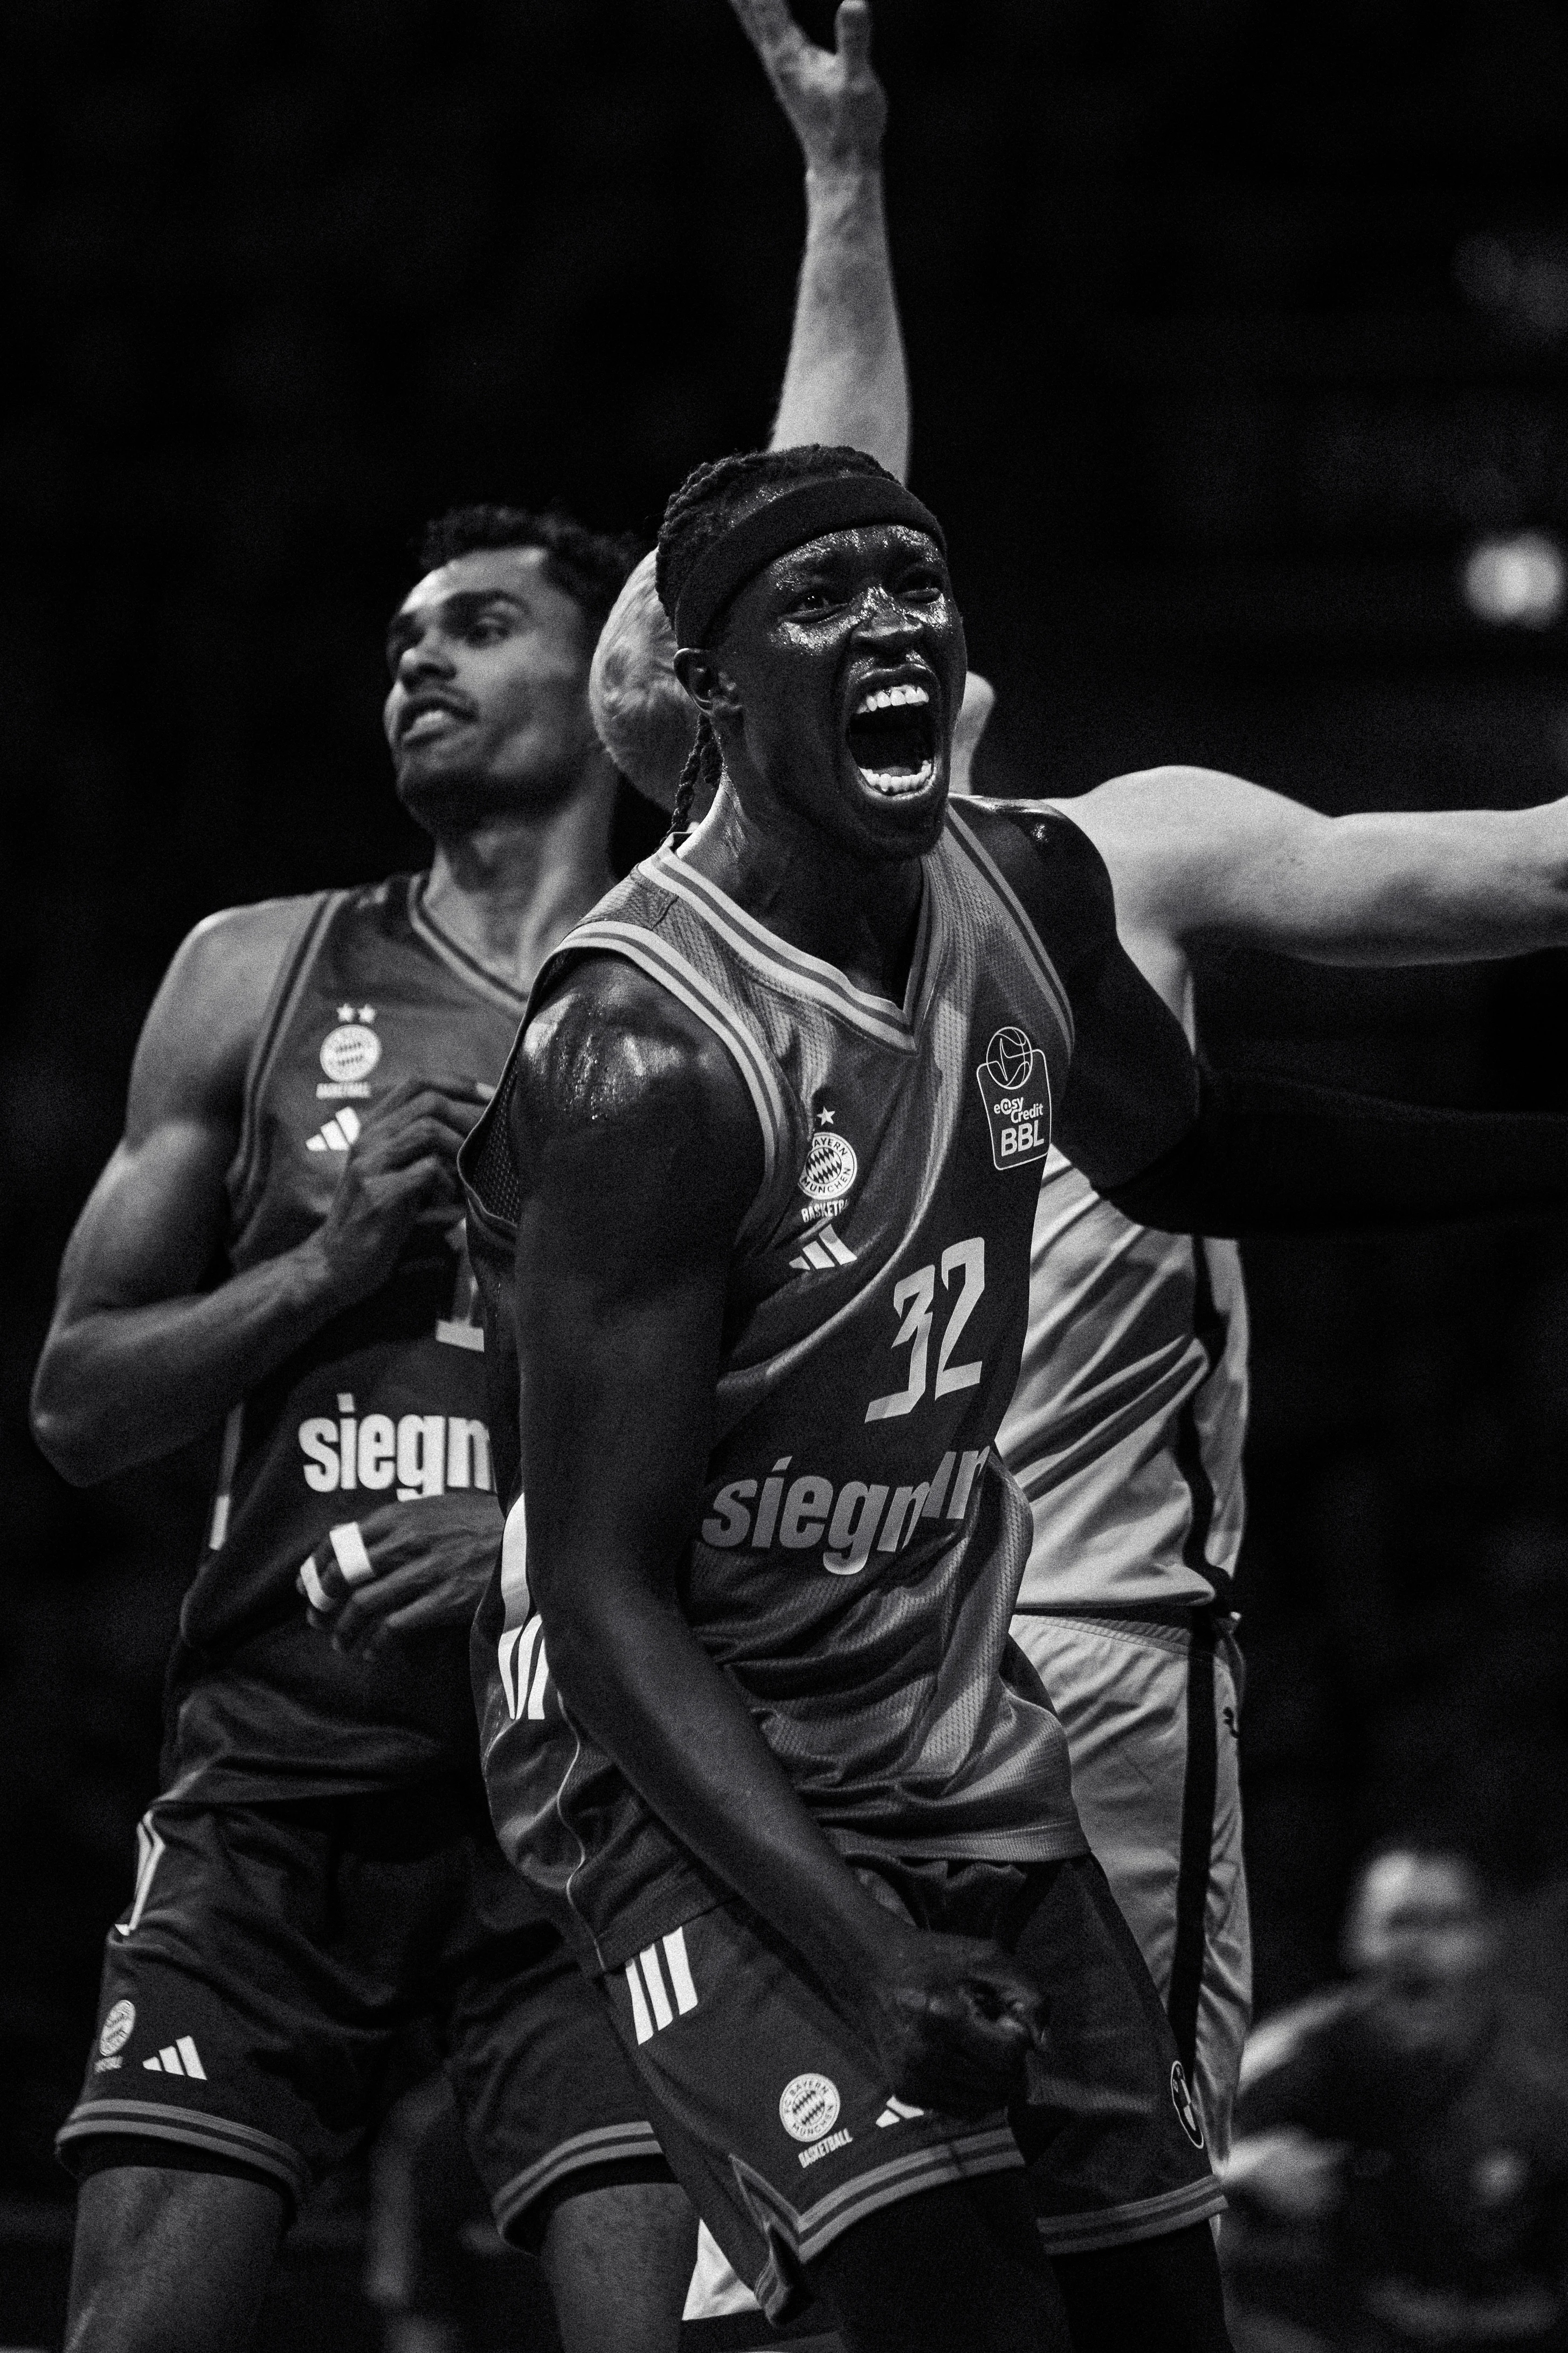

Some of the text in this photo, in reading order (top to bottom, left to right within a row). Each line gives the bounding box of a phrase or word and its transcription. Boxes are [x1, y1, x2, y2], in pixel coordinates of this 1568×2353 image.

[1011, 1103, 1044, 1124] Credit
[814, 1137, 848, 1156] AYERN
[1001, 1119, 1045, 1157] BBL
[864, 1236, 985, 1424] 32
